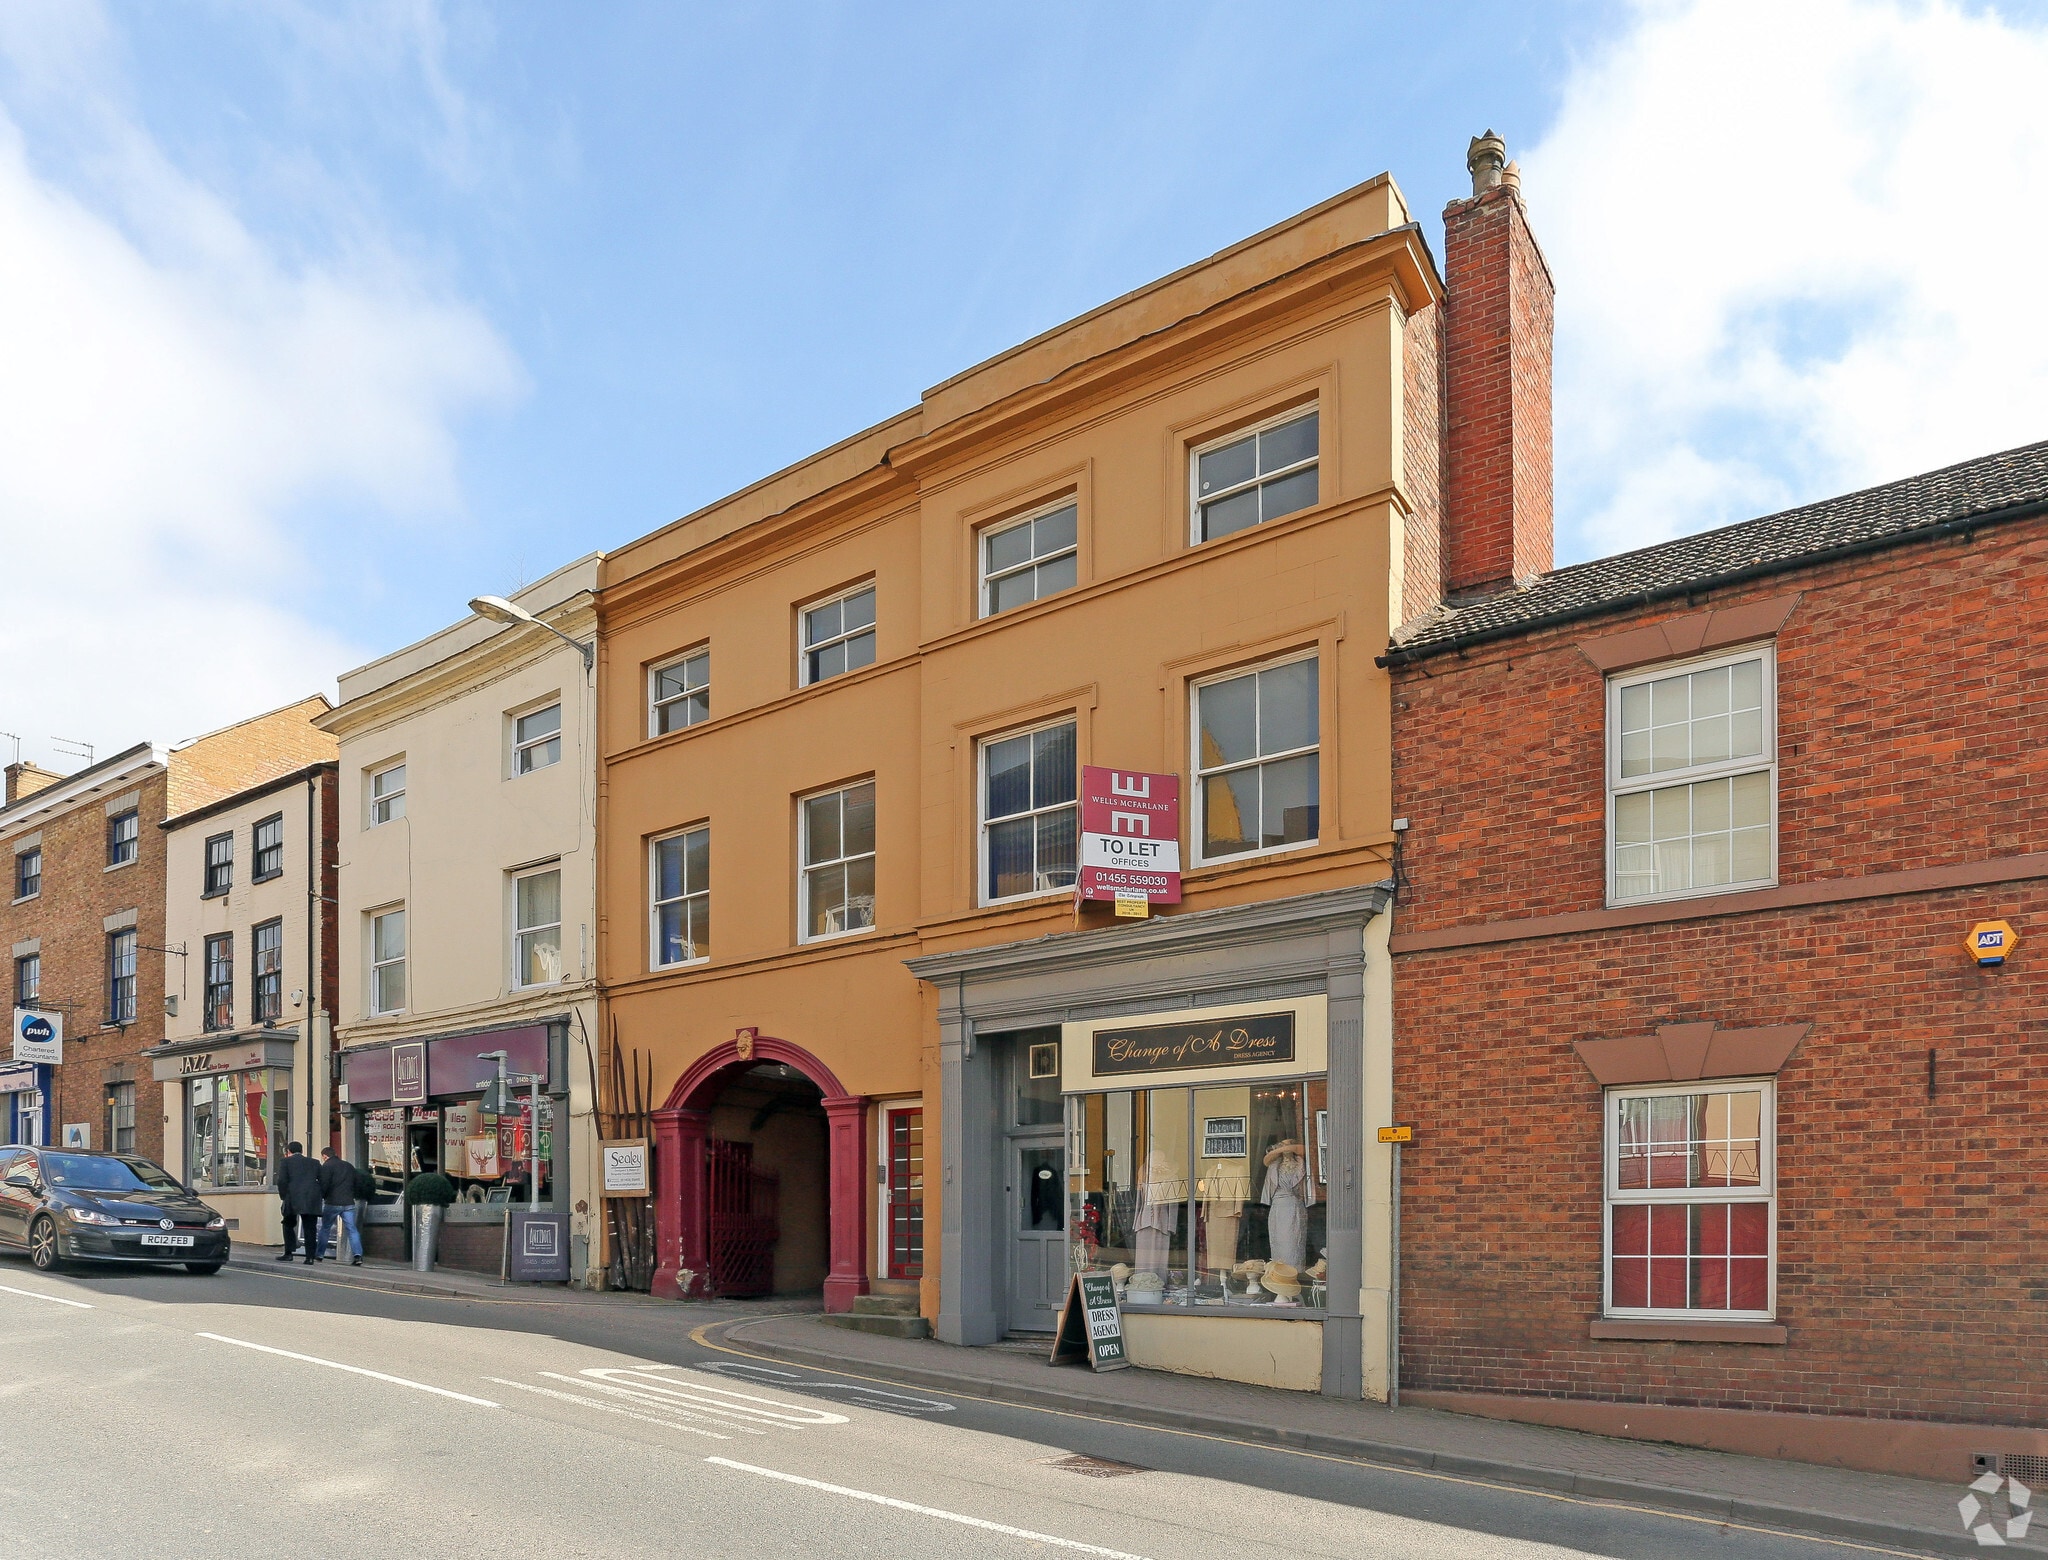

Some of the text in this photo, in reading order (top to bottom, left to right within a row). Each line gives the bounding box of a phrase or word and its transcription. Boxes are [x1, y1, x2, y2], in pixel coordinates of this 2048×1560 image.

[1091, 795, 1169, 811] WELLS MCFARLANE
[1100, 838, 1161, 857] TO LET
[1111, 857, 1150, 868] OFFICES
[1095, 871, 1168, 886] 01455 559030
[1096, 884, 1168, 895] wellsmcfarlane.co.uk
[1978, 932, 2004, 946] ADT
[26, 1027, 50, 1036] pwh
[22, 1045, 55, 1054] Chartered
[1107, 1028, 1277, 1064] Change of A Dress
[18, 1052, 59, 1061] Accountants
[1233, 1049, 1276, 1059] DRESS AGENCY
[179, 1053, 210, 1074] JAZZ
[147, 1235, 189, 1245] RC12 FEB
[1084, 1281, 1112, 1294] Change of
[1096, 1295, 1113, 1305] Dress
[1091, 1309, 1115, 1323] DRESS
[1093, 1323, 1119, 1337] AGENCY
[1098, 1343, 1120, 1357] OPEN
